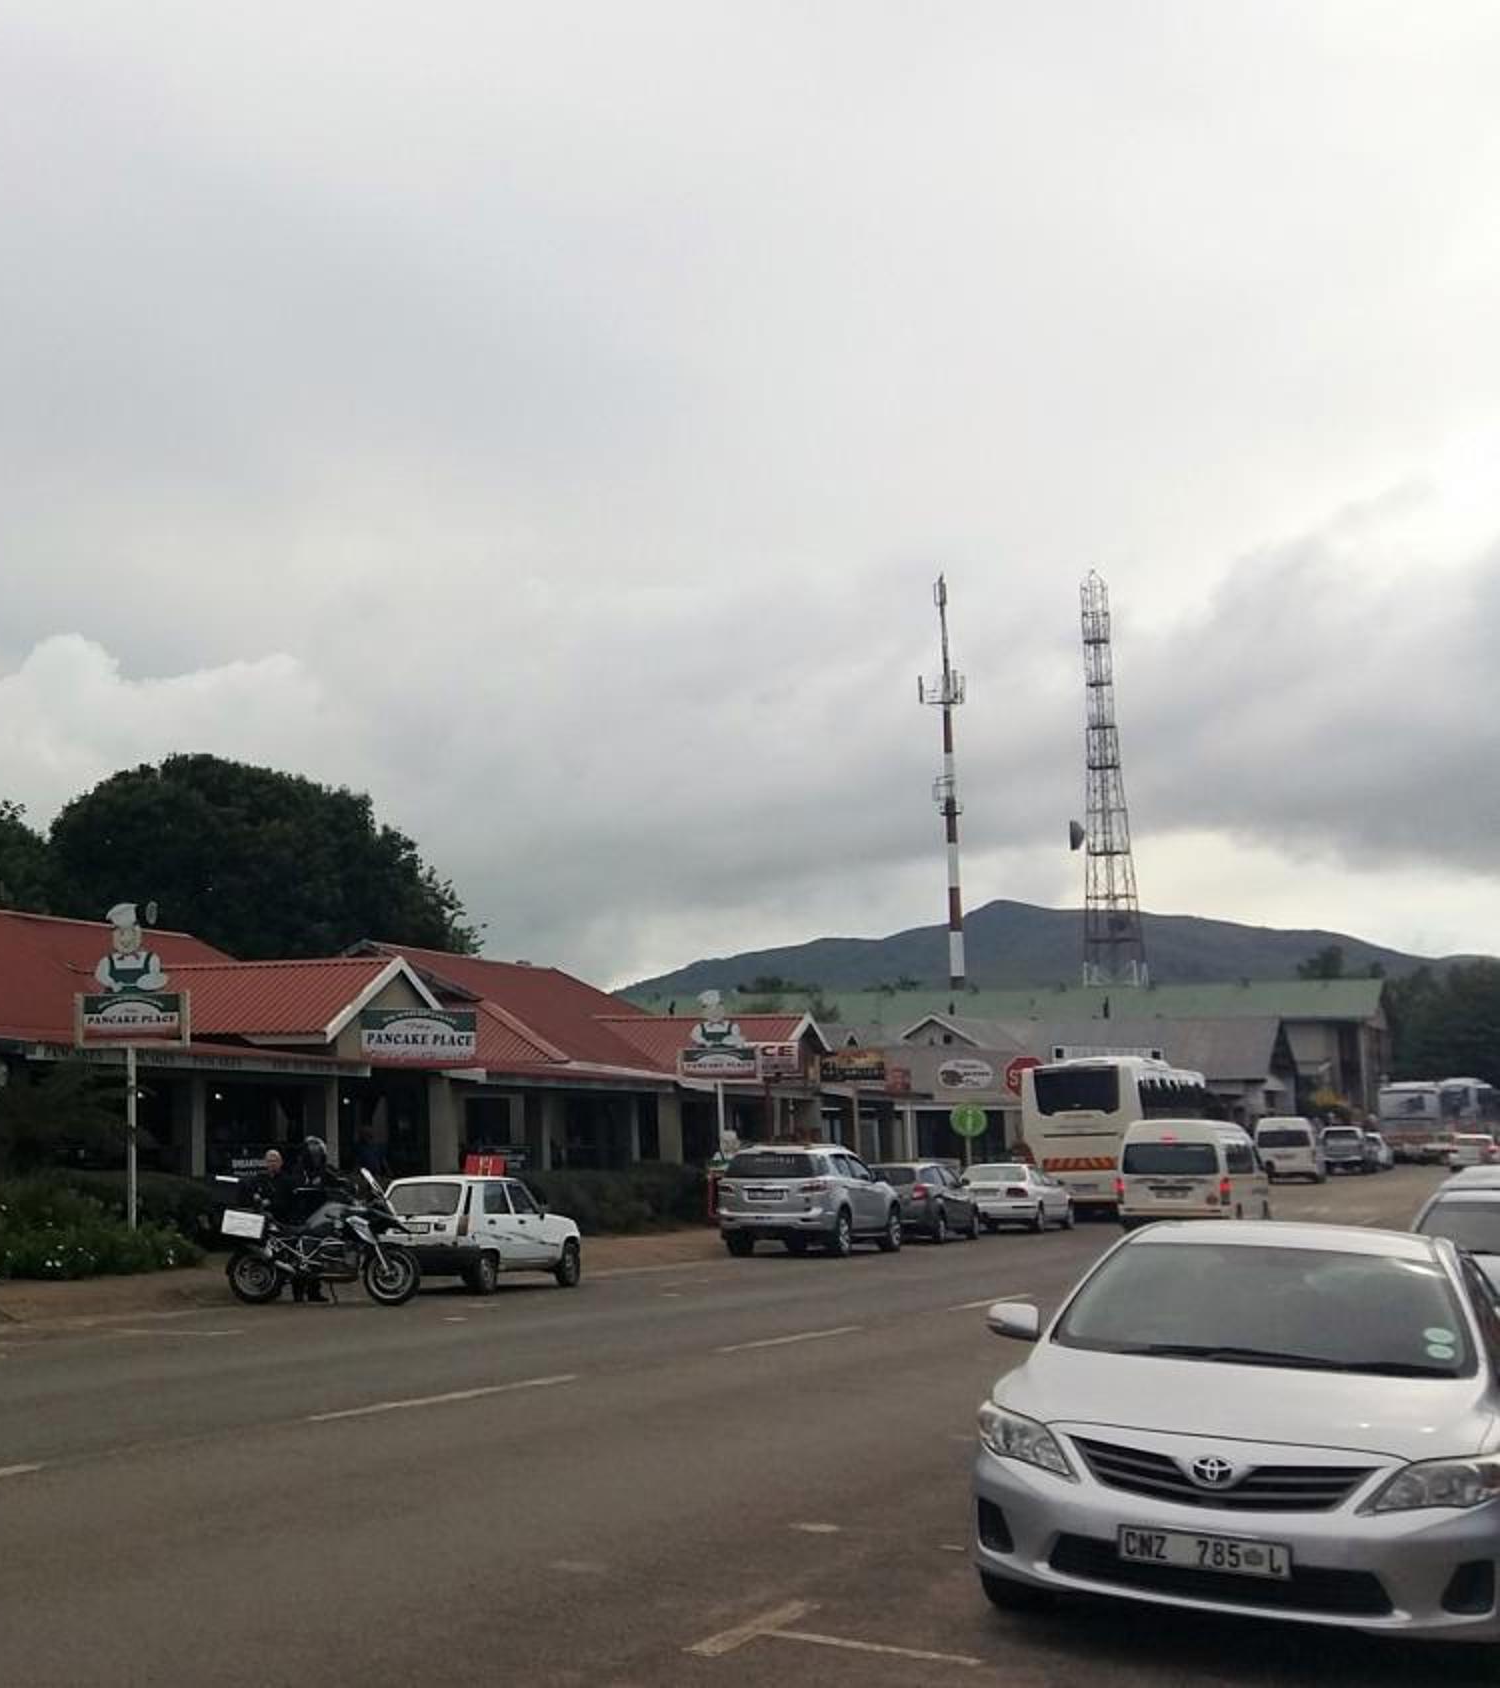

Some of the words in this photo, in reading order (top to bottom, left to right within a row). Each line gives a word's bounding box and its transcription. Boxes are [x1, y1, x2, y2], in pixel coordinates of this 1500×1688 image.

[87, 1015, 140, 1025] PANCAKE
[141, 1014, 177, 1024] PLACE
[366, 1033, 430, 1046] PANCAKE
[432, 1034, 473, 1047] PLACE
[1124, 1531, 1168, 1560] CNZ
[1195, 1540, 1241, 1569] 785
[1267, 1547, 1283, 1574] L
